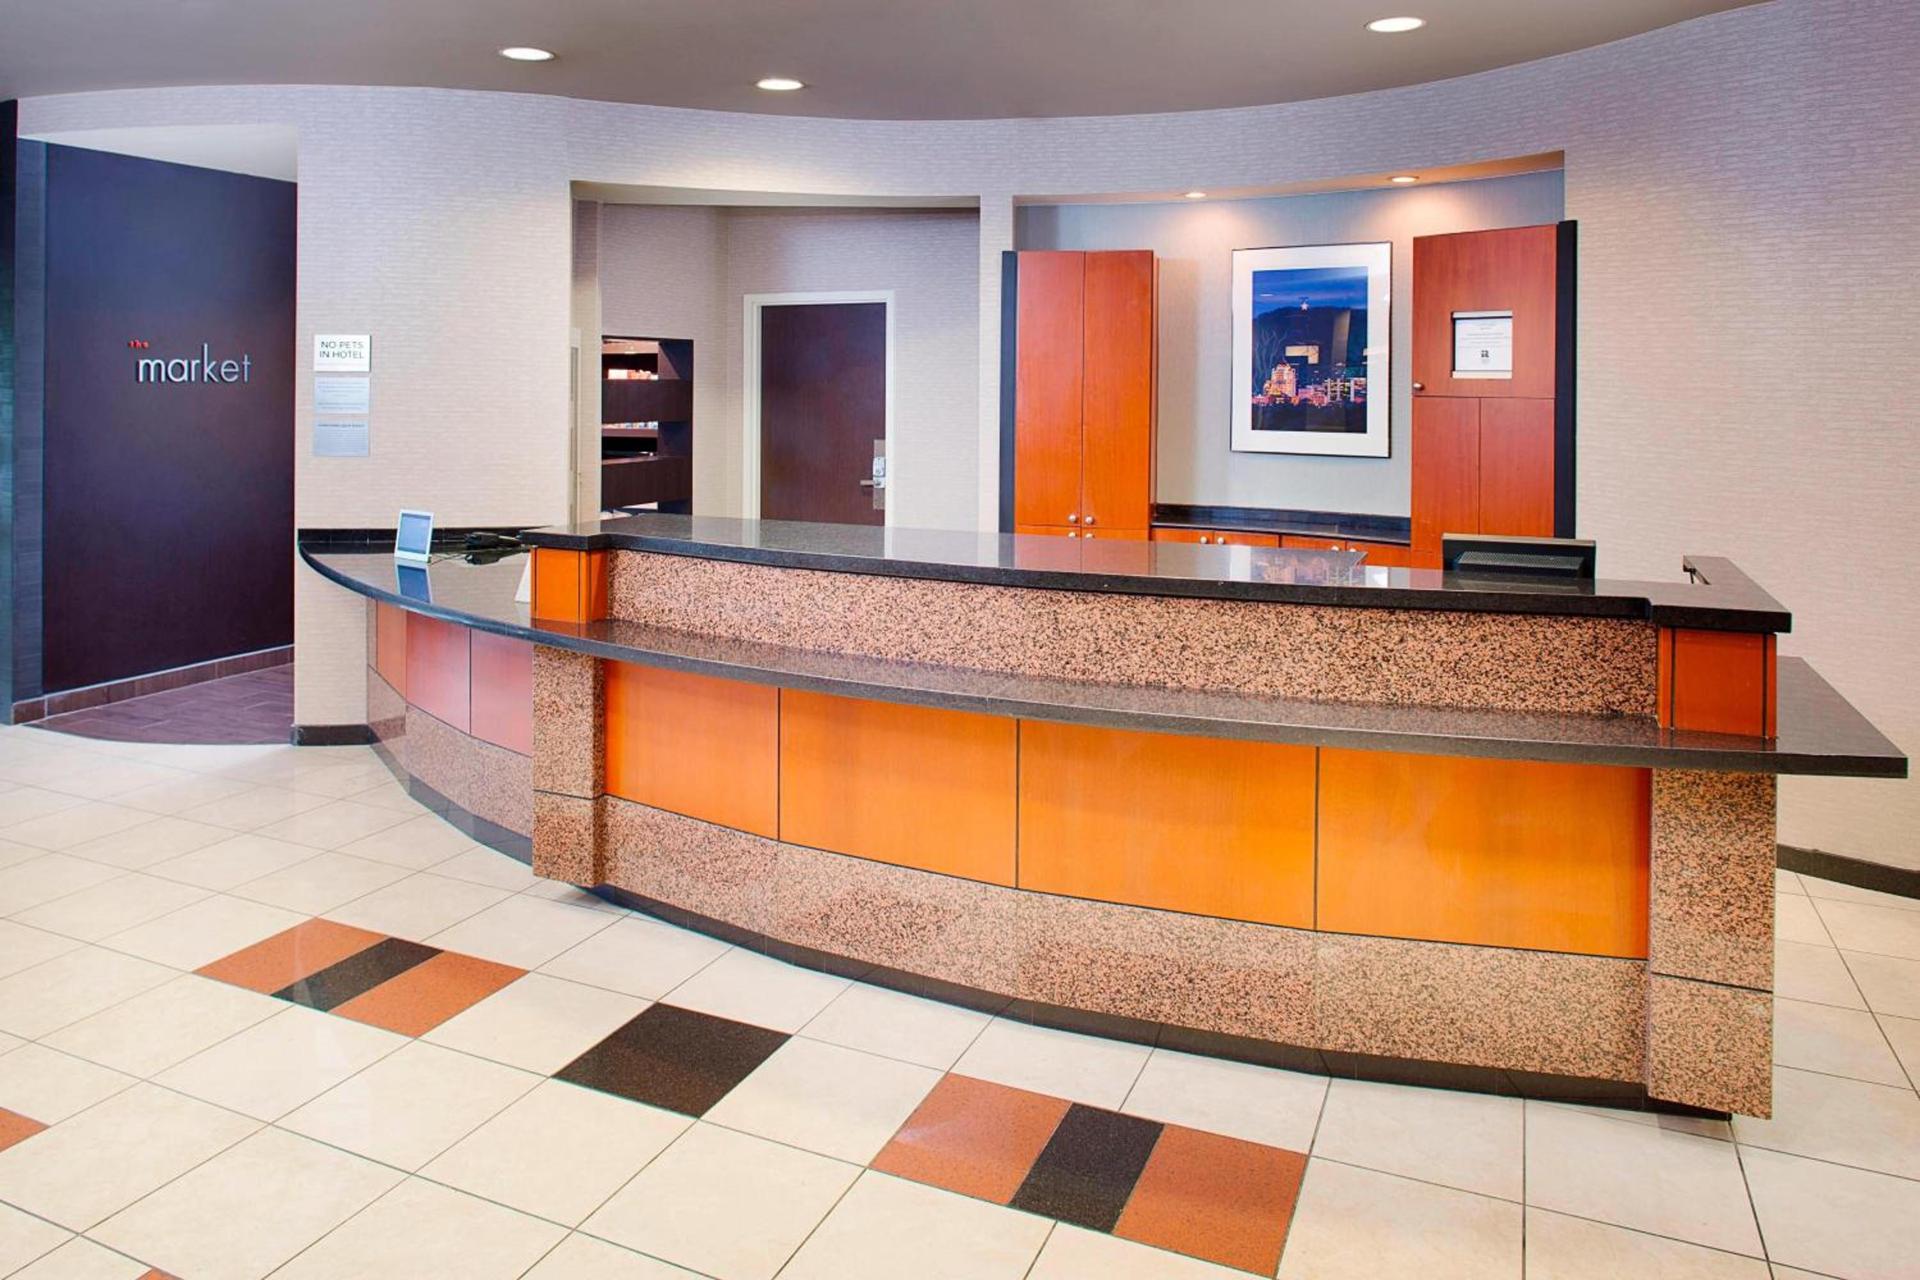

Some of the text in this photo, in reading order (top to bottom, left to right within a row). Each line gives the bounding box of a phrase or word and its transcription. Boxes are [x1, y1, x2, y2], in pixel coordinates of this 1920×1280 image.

[129, 340, 149, 348] the
[320, 341, 364, 349] NO PETS
[319, 350, 364, 359] IN HOTEL
[138, 343, 251, 383] market
